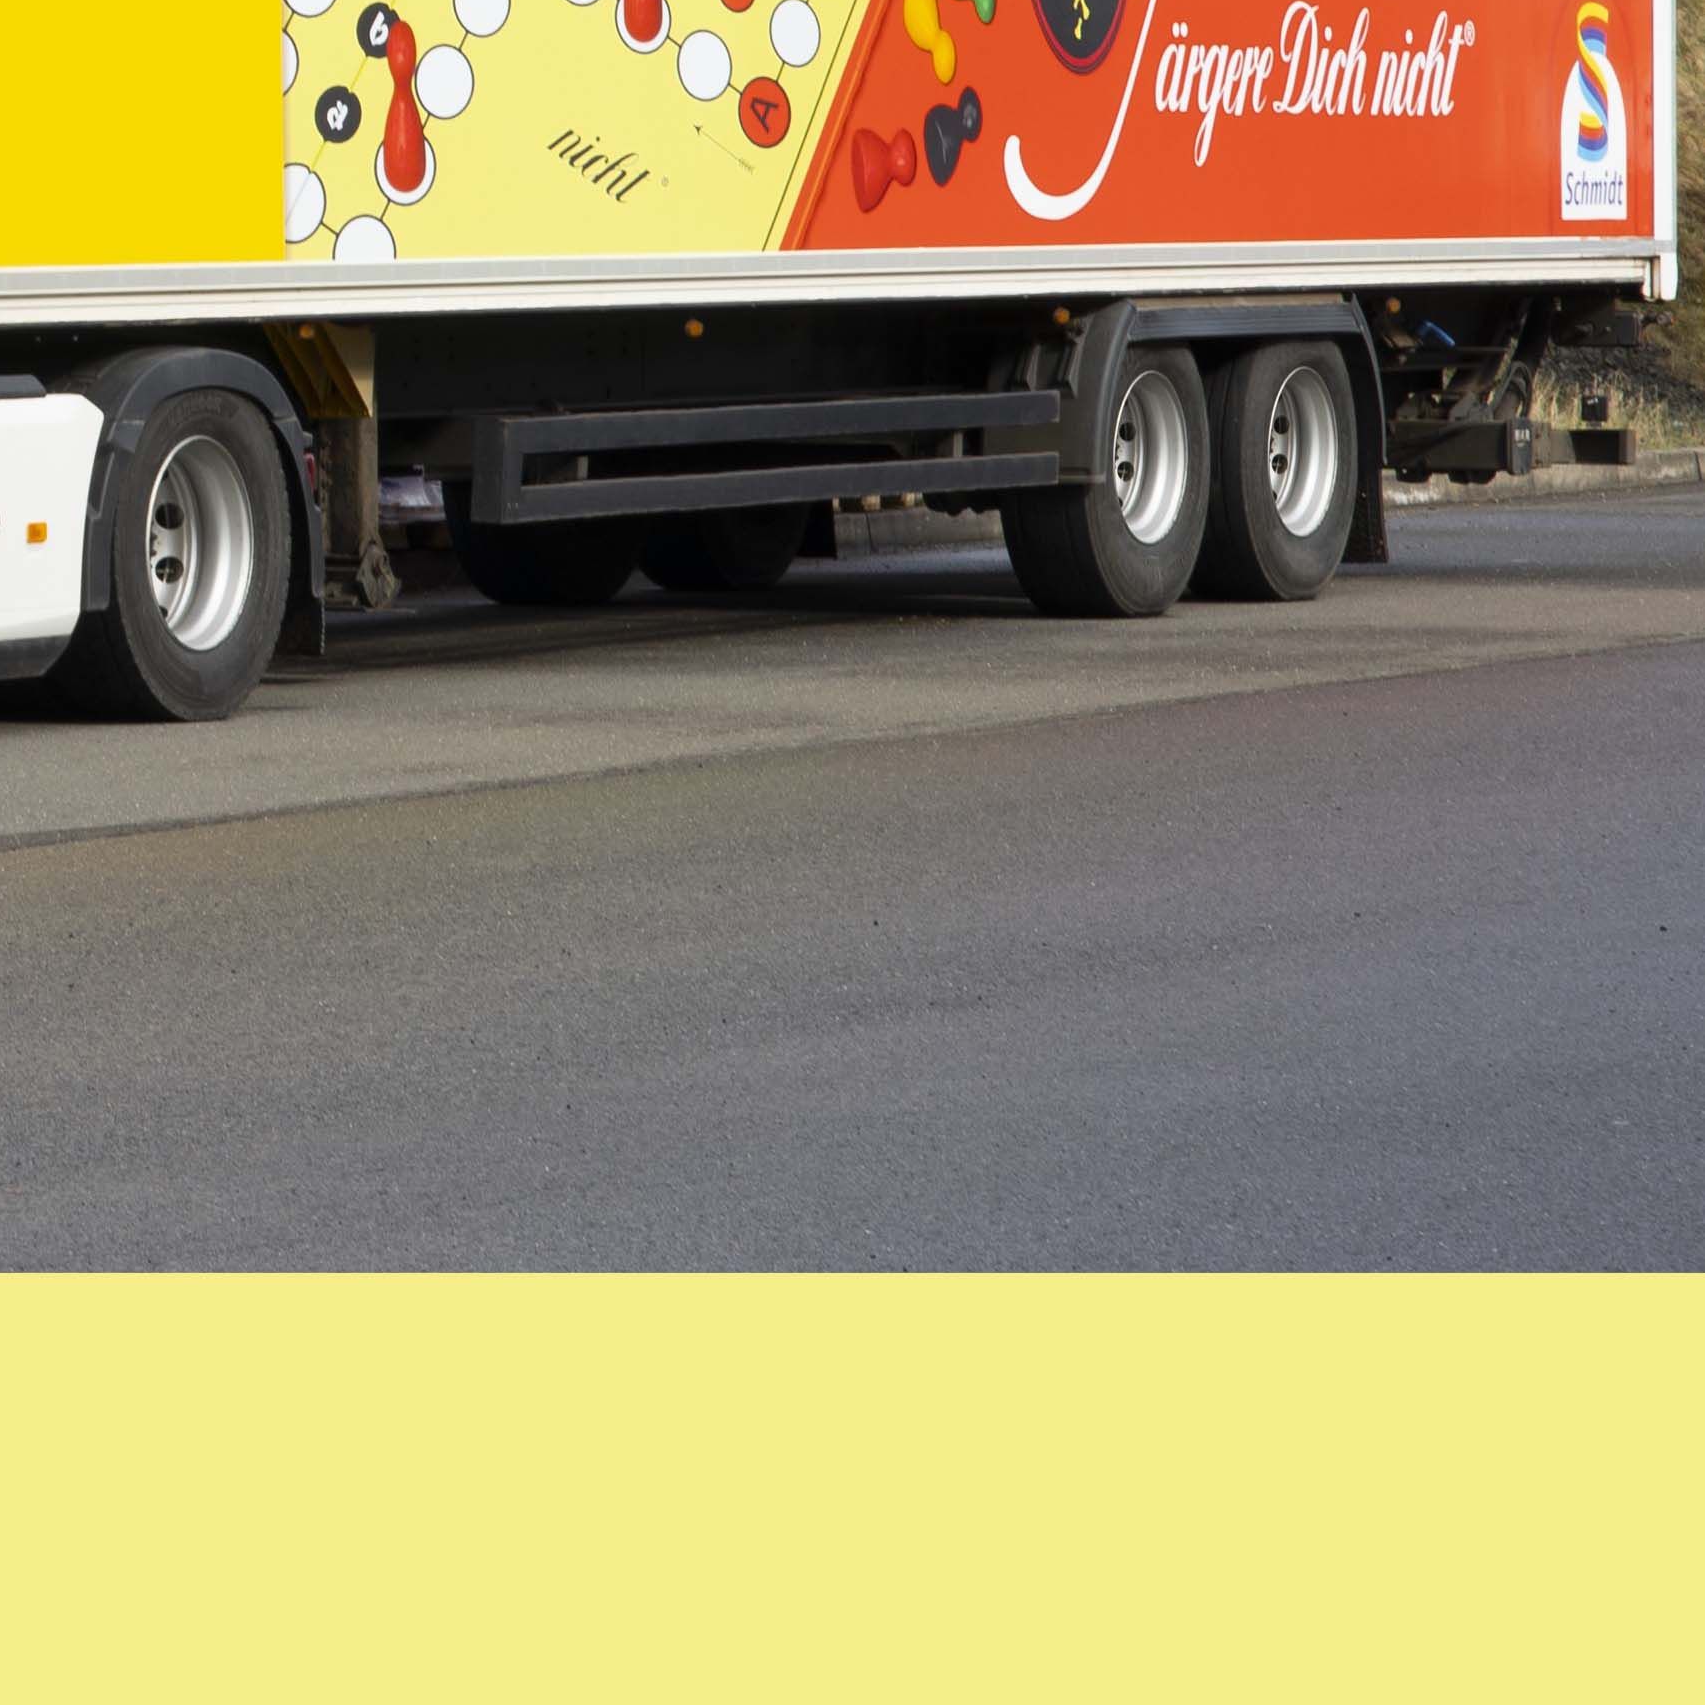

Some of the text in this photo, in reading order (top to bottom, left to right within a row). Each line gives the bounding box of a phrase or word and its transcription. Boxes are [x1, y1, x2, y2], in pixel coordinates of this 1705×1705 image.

[1155, 22, 1274, 167] ärgere
[1272, 0, 1369, 116] Dich
[546, 129, 651, 203] nicht
[1564, 171, 1624, 205] Schmidt
